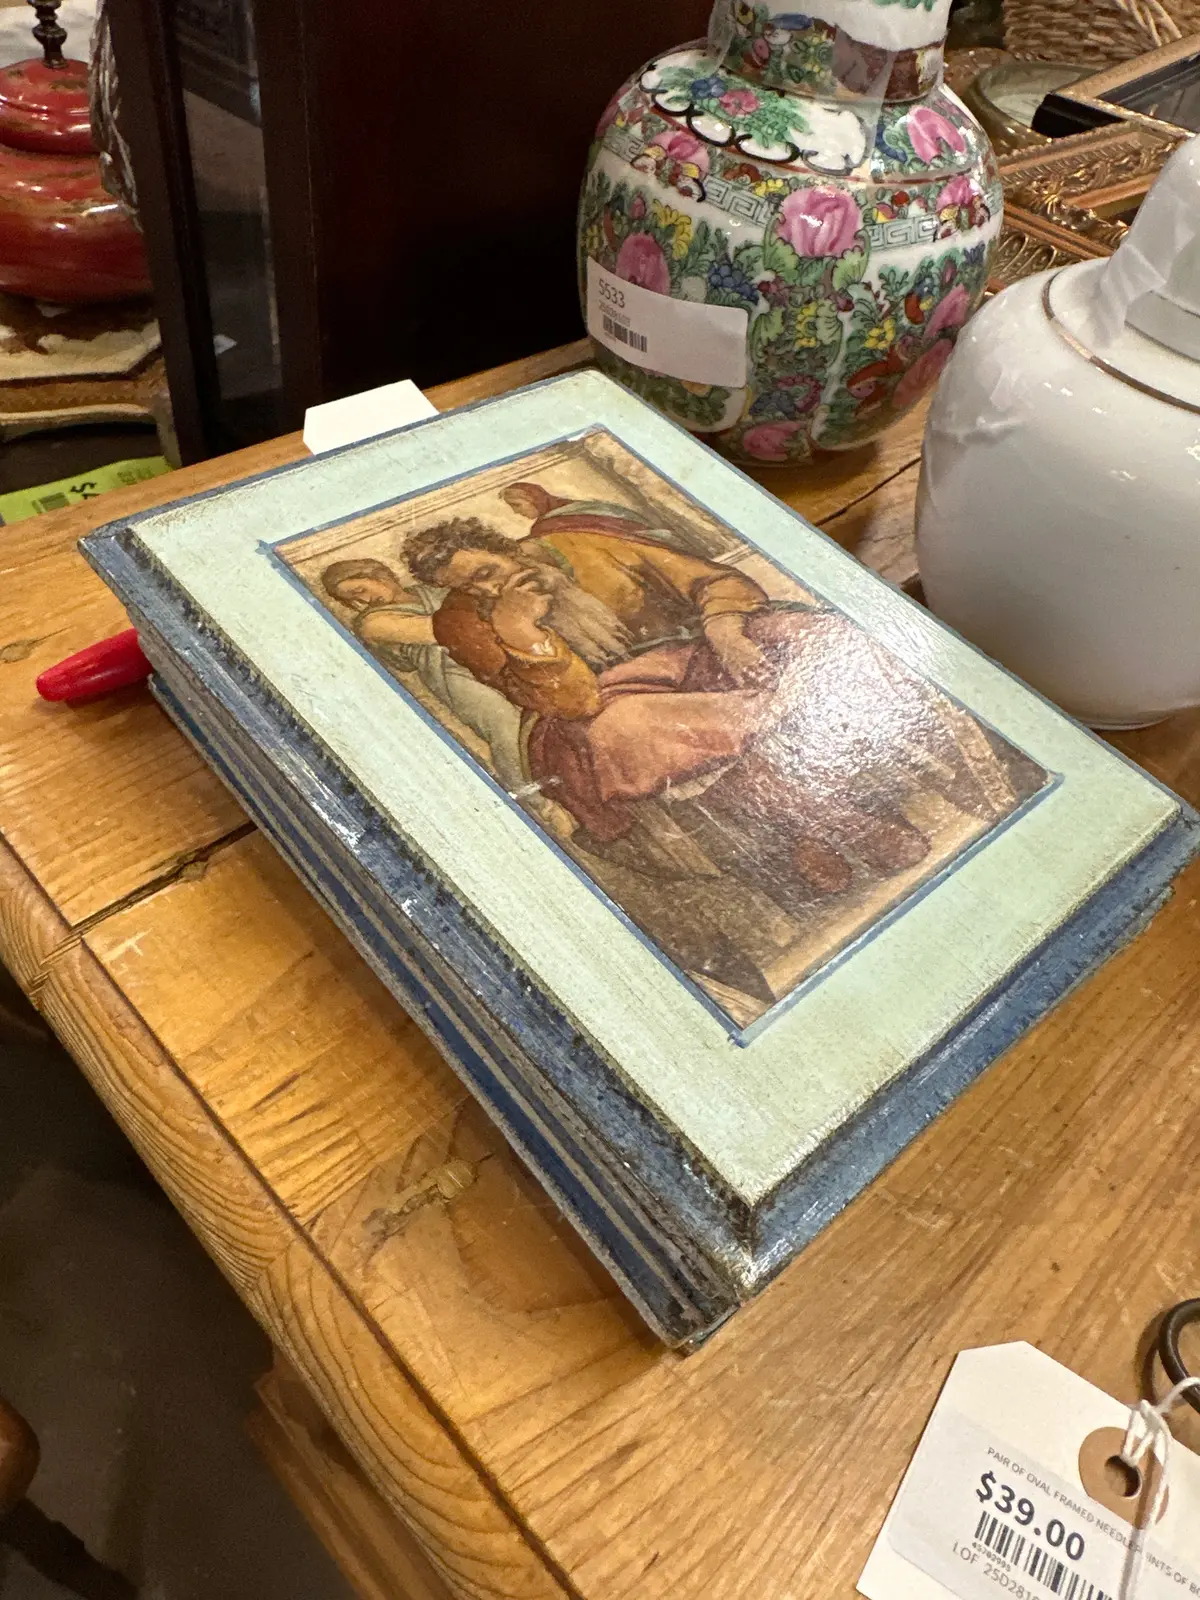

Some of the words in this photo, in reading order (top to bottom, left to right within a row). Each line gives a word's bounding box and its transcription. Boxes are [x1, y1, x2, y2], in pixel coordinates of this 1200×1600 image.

[953, 1541, 979, 1564] LOF
[975, 1470, 1085, 1561] $39.00
[987, 1447, 1010, 1468] PAIR
[1012, 1463, 1027, 1479] OF
[1027, 1472, 1051, 1496] OVAL
[1054, 1491, 1095, 1523] FRAMED
[1173, 1571, 1188, 1584] OF
